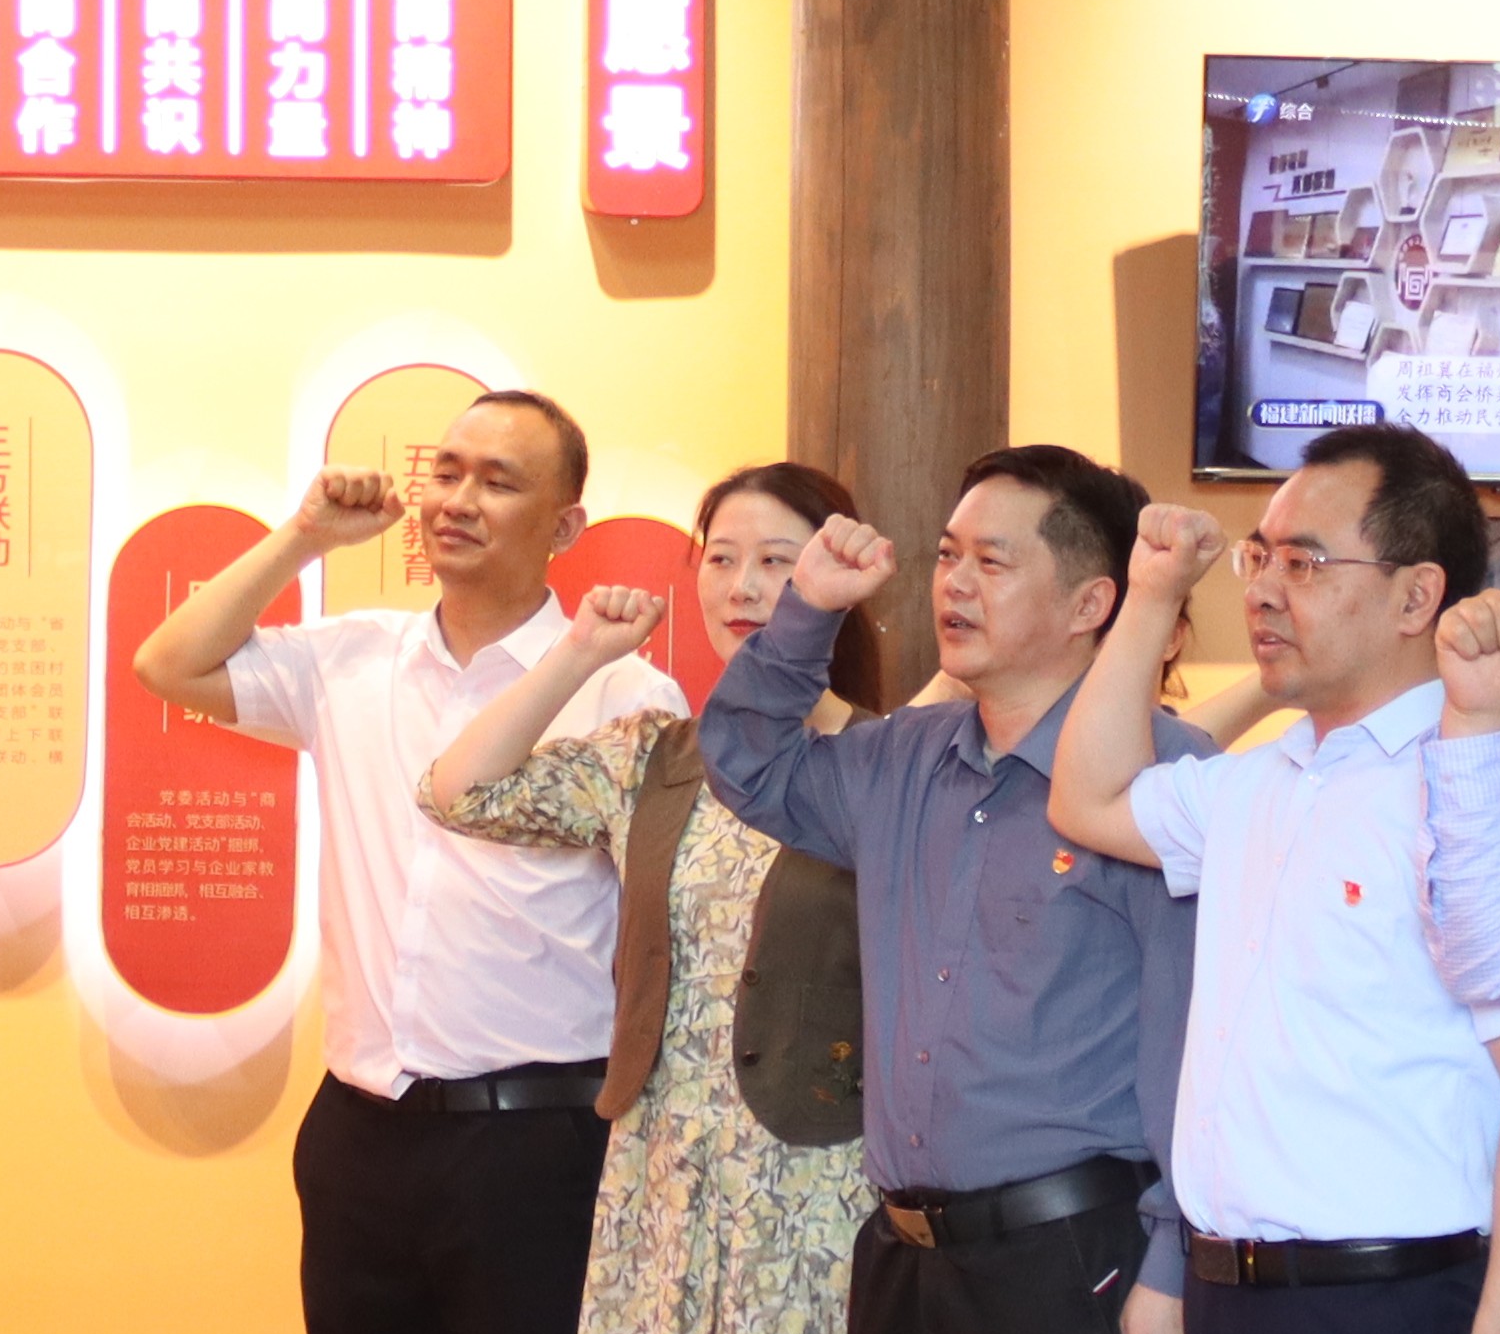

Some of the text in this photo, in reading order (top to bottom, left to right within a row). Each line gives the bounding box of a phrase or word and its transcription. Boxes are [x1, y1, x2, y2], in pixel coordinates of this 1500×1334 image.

[1279, 102, 1315, 121] 综合
[1259, 402, 1377, 425] 福建新闻联播
[124, 858, 275, 877] 党员学习与企业家教
